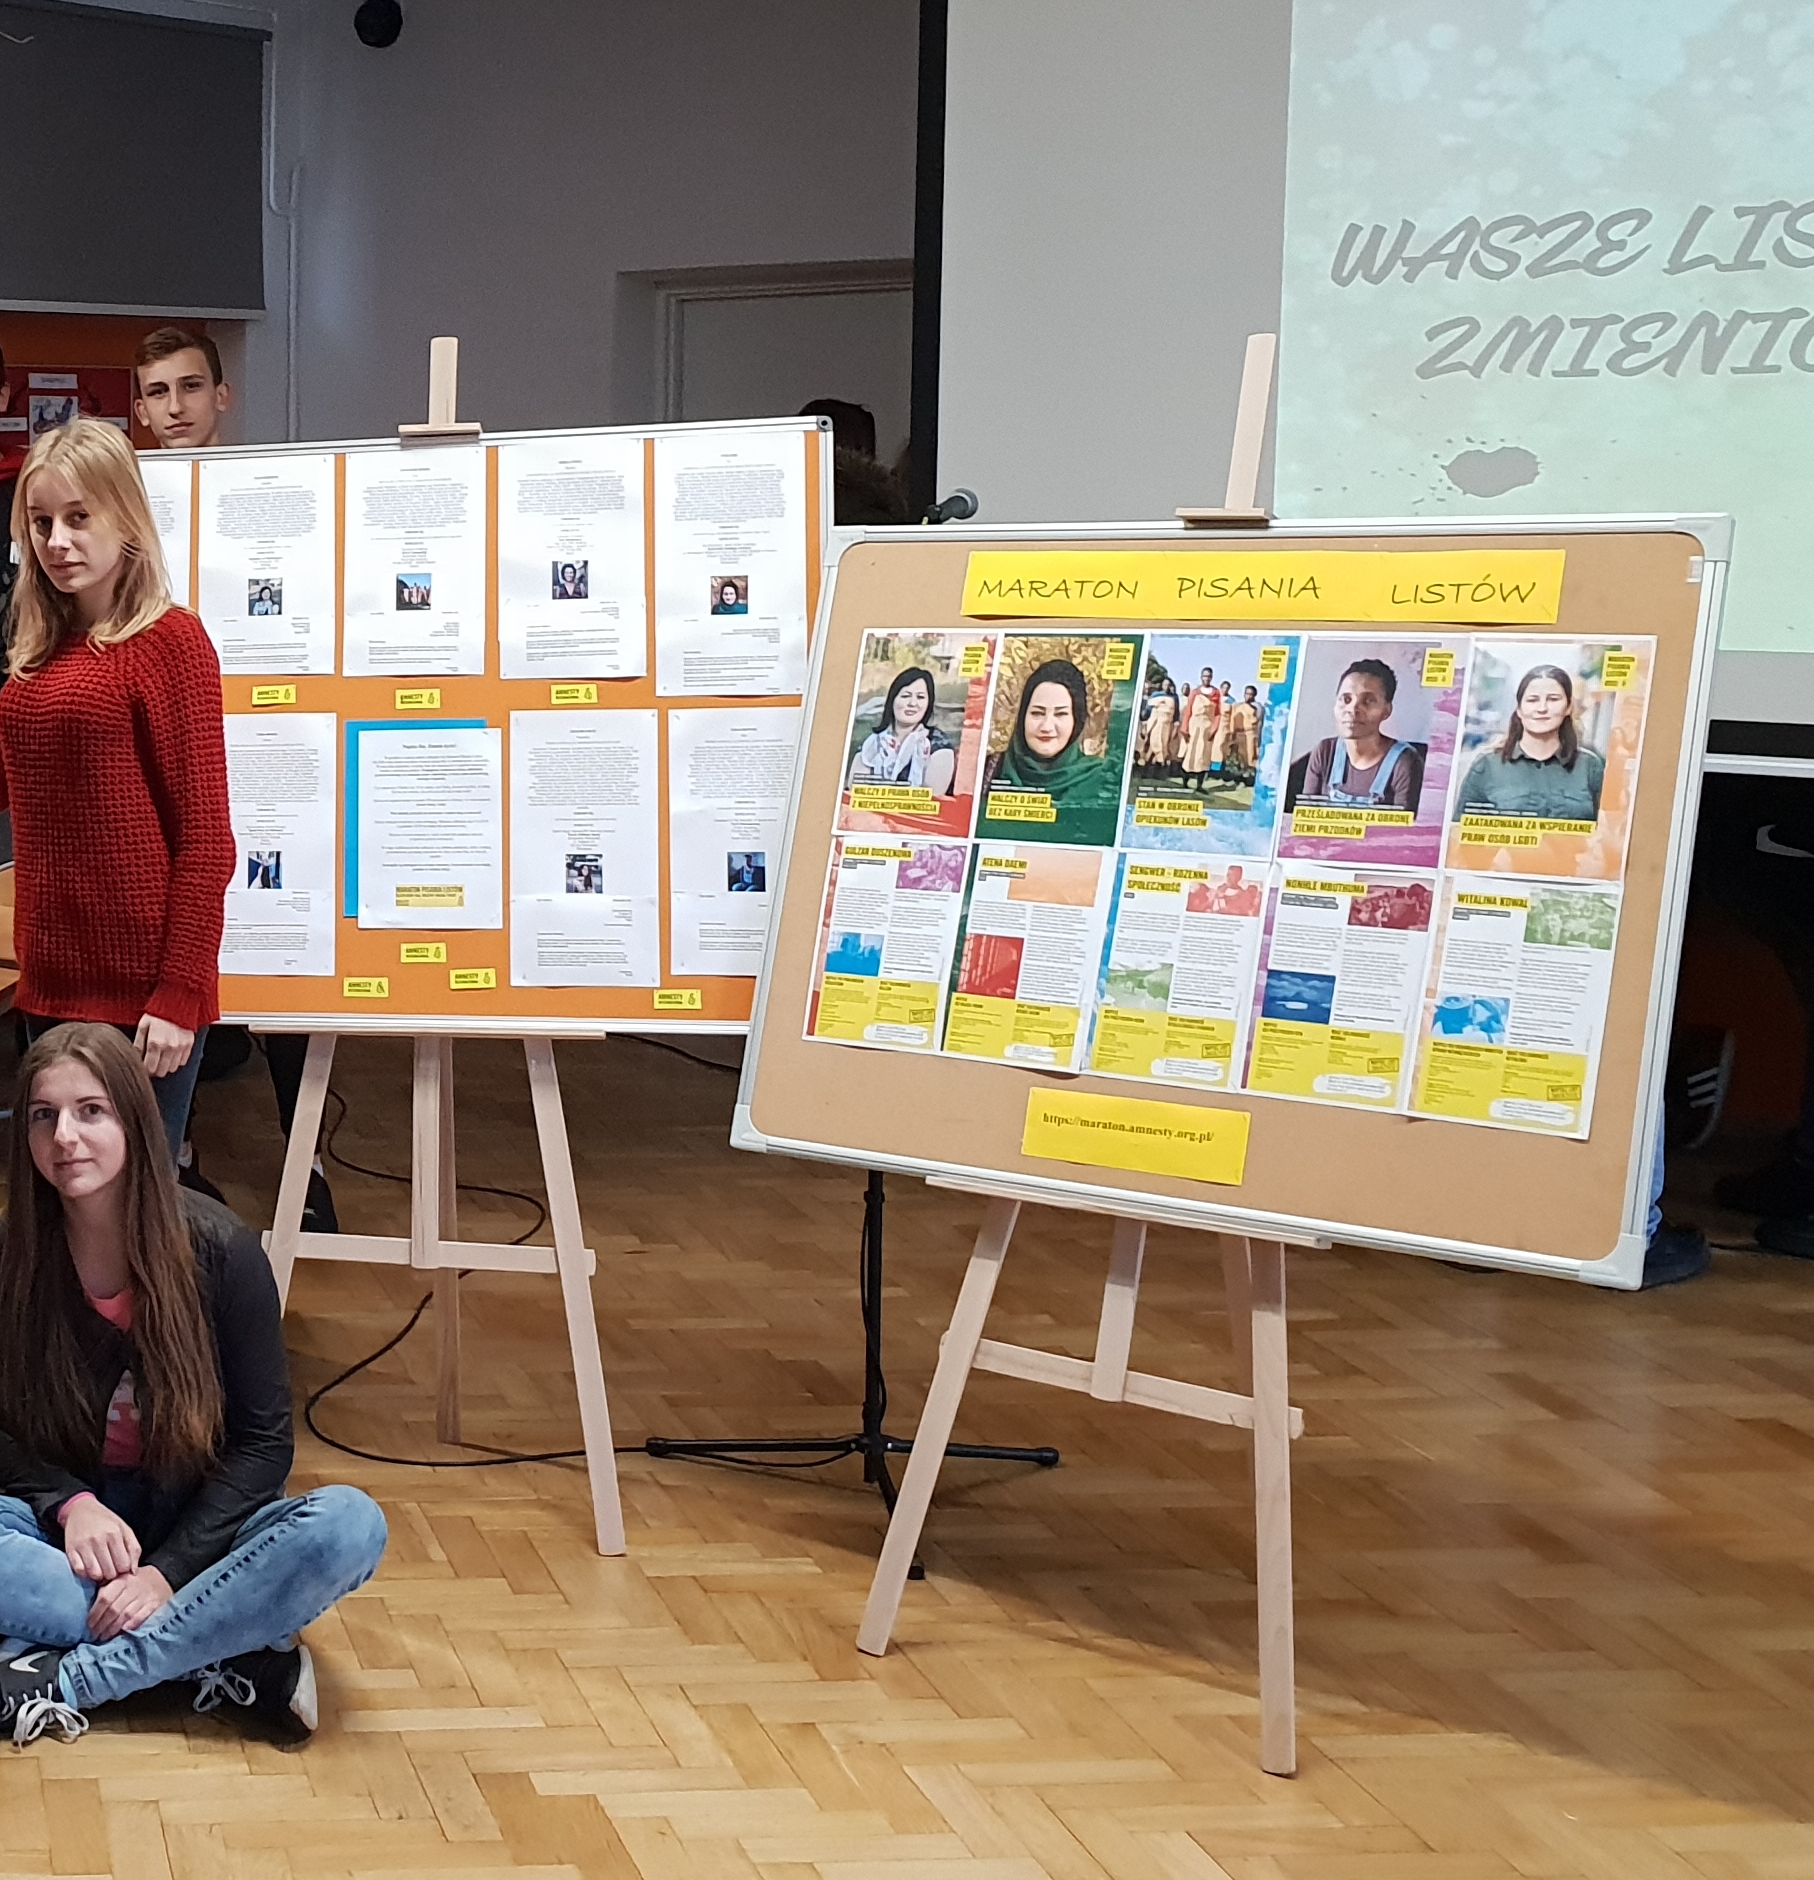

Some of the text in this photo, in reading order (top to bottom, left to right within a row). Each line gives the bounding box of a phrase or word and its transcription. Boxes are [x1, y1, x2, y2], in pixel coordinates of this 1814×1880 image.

[1331, 208, 1652, 287] WASZE
[978, 573, 1537, 606] MARATON PISANIA LISTÓW
[1365, 813, 1376, 821] ZA
[1525, 820, 1537, 830] ZA
[1043, 1112, 1215, 1144] https://maraton.amnesty.org.pl/
